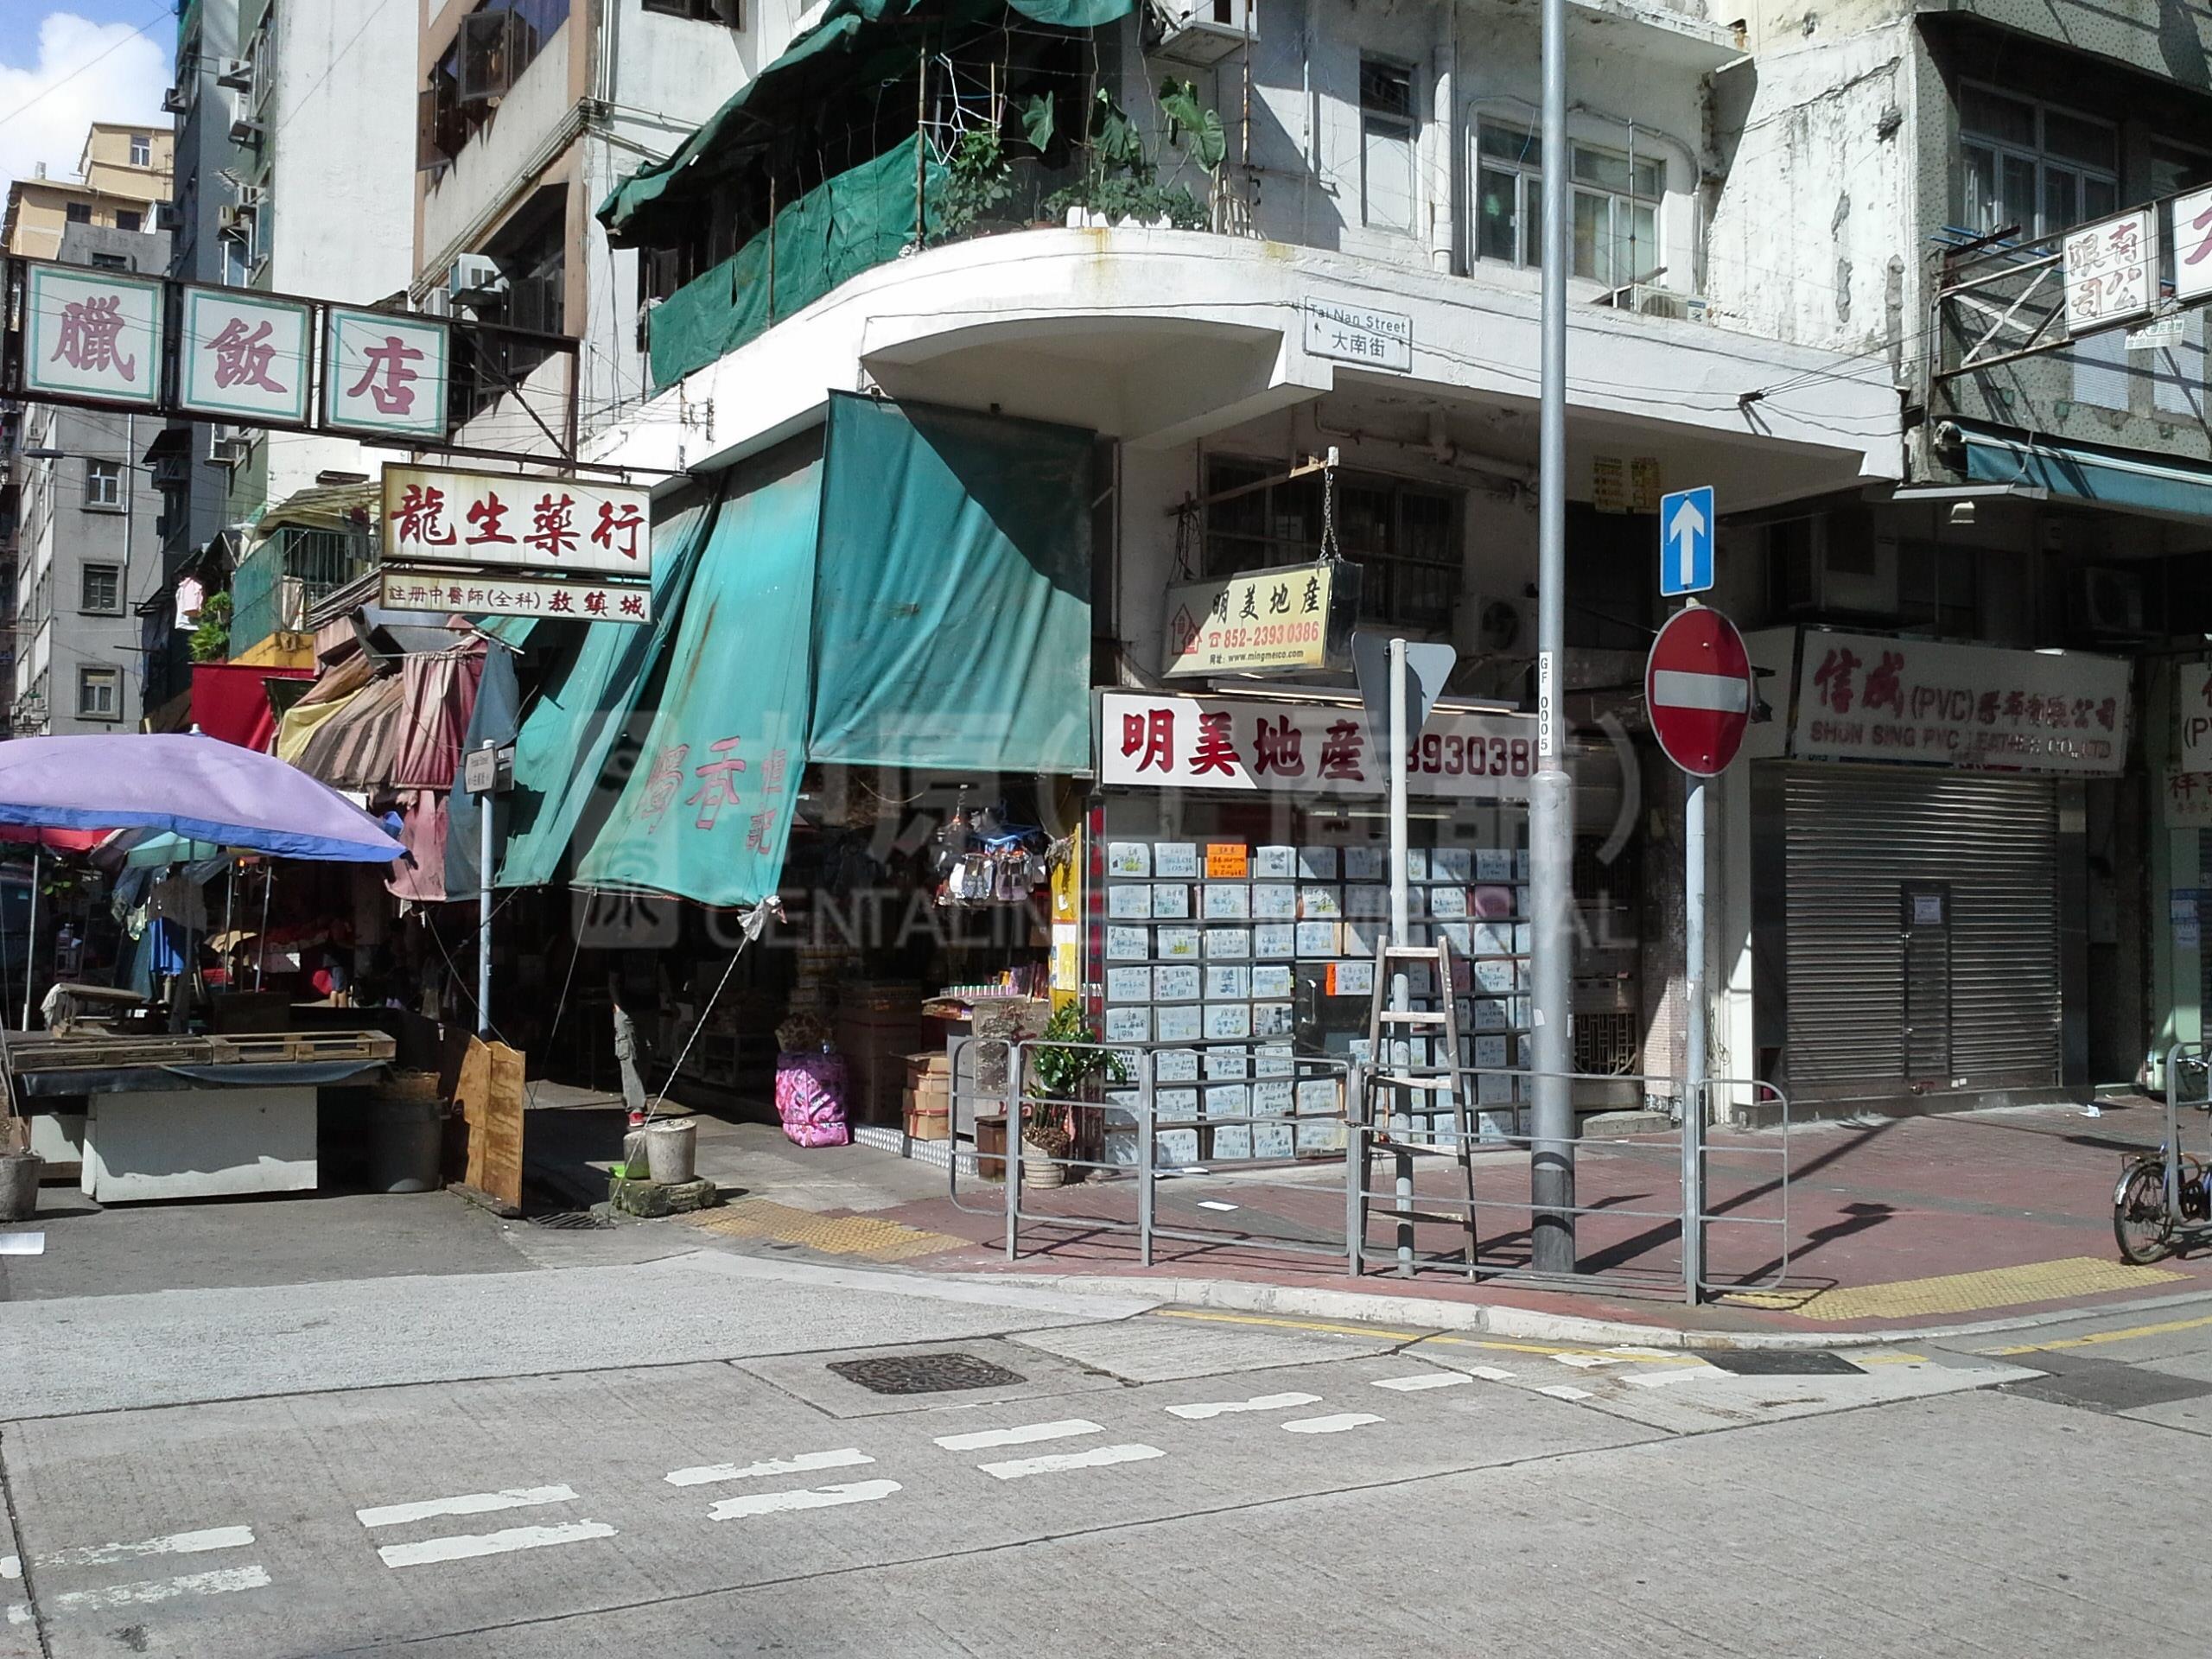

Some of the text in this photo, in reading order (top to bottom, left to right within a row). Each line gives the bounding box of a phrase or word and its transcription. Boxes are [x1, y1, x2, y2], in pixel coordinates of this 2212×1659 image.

[1310, 303, 1406, 334] Tai Nan Street
[1332, 331, 1385, 358] 大南街
[391, 484, 645, 560] 龍生藥行
[1540, 696, 1549, 751] 0005
[1810, 720, 1863, 745] SHUN
[1872, 724, 1916, 749] SING
